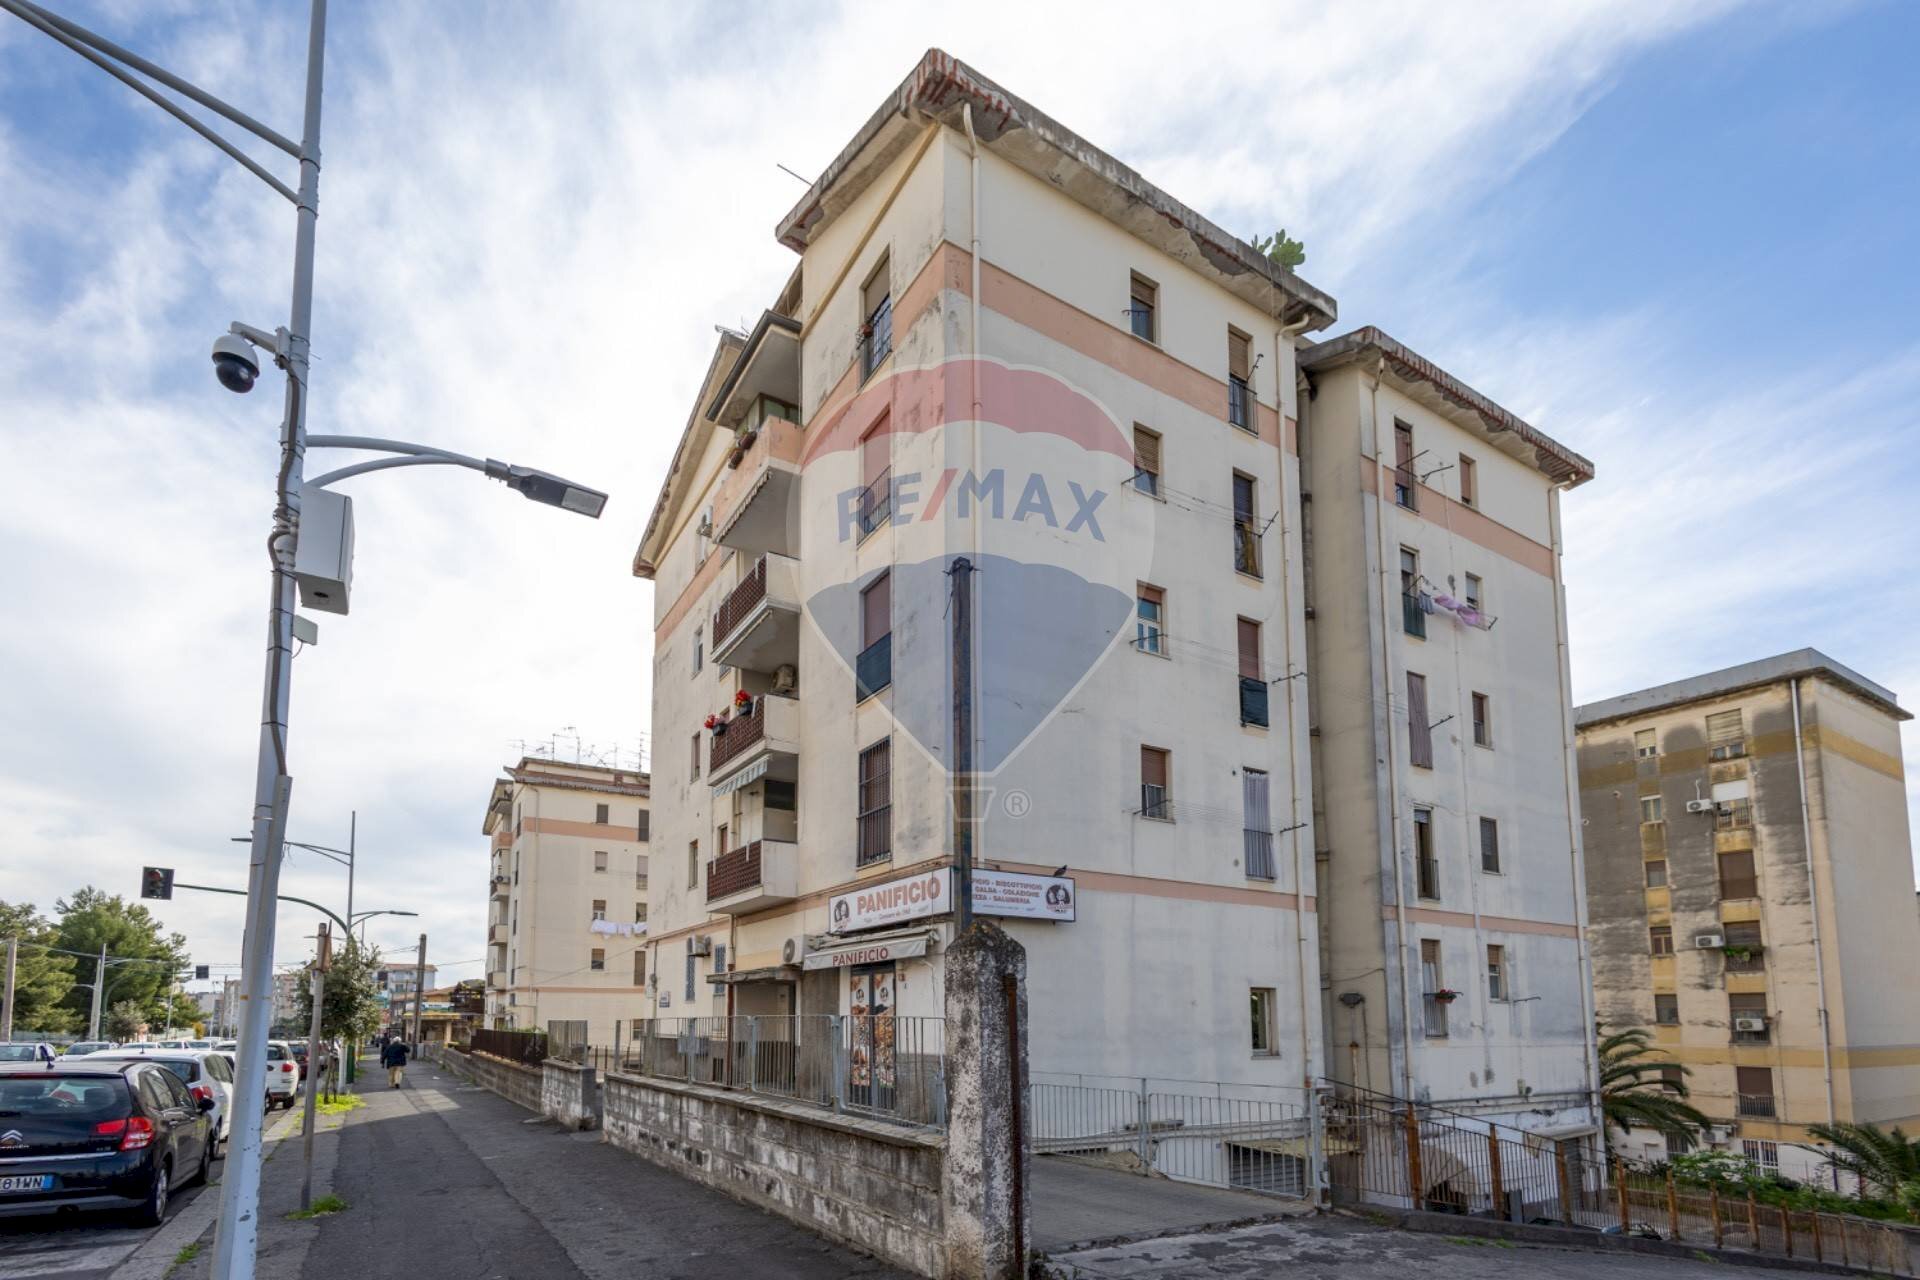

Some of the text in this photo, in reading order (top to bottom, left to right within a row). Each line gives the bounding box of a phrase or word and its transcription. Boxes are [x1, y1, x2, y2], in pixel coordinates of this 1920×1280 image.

[857, 876, 941, 915] PANIFICIO
[832, 947, 889, 966] PANIFICIO
[0, 1176, 42, 1190] 81WN
